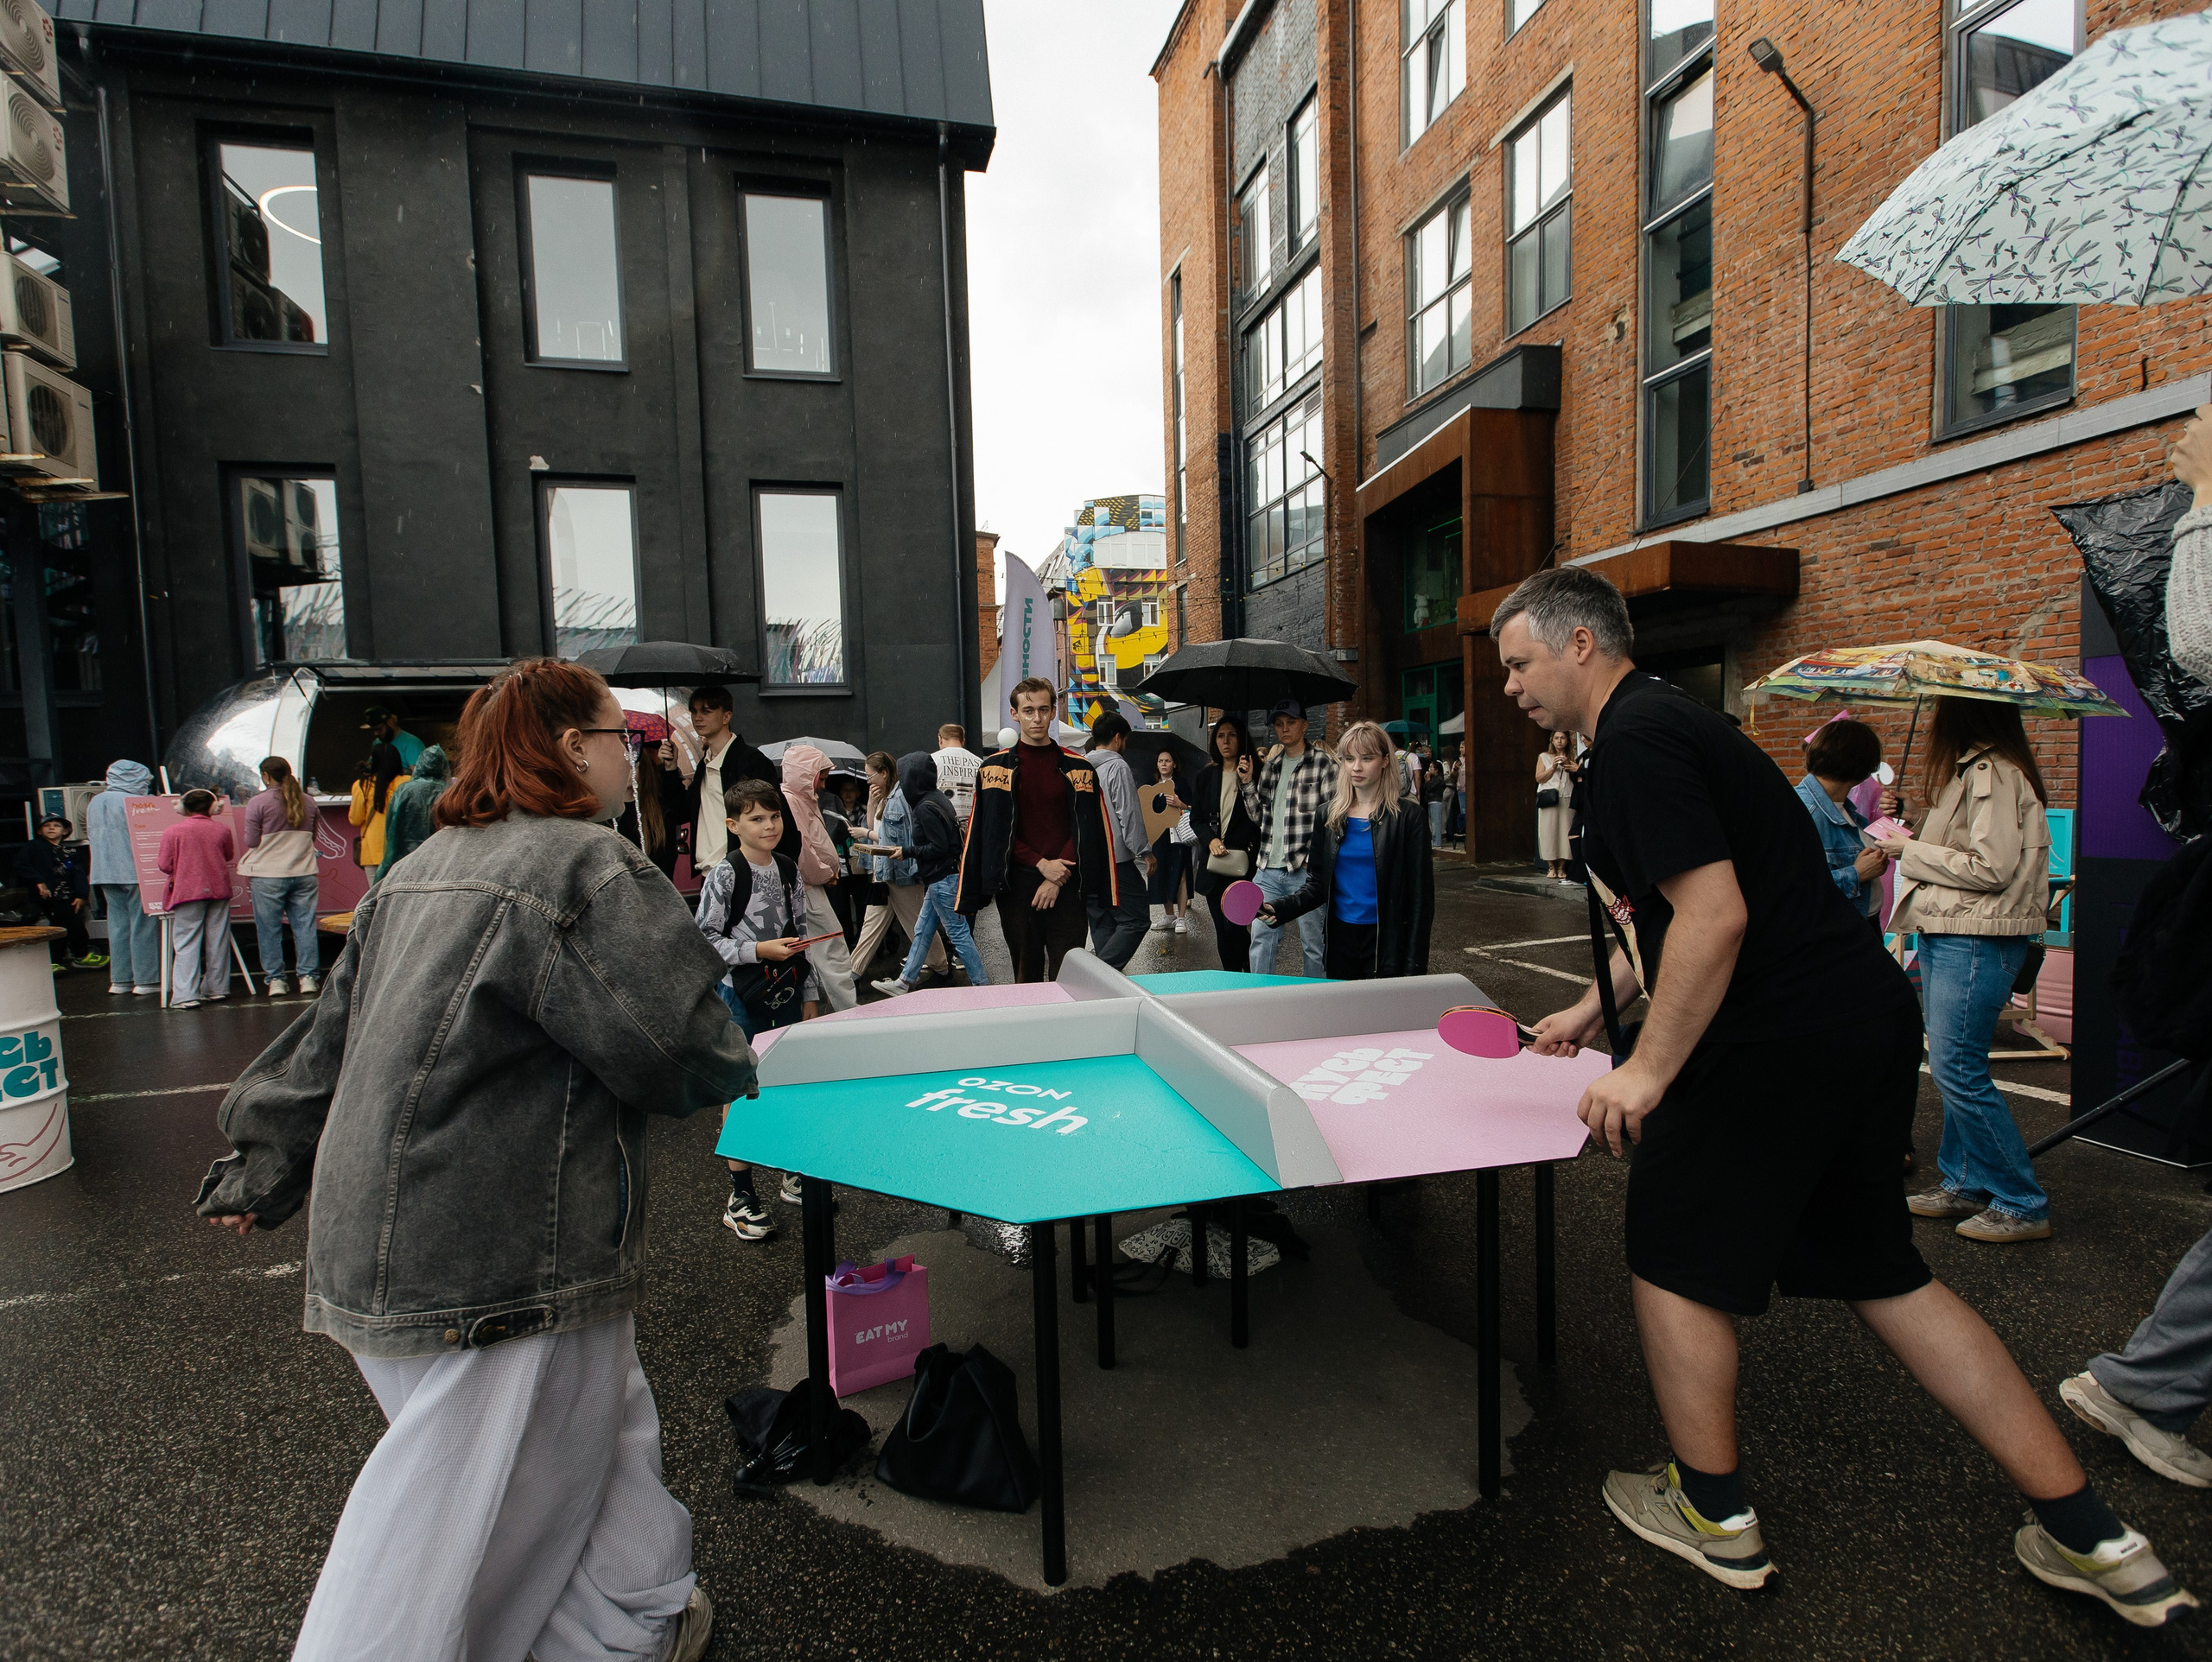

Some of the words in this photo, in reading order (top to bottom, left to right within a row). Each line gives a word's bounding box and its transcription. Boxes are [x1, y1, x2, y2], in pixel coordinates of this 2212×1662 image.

[940, 756, 960, 766] THE
[957, 1077, 1073, 1101] OZON
[905, 1088, 1089, 1135] fresh
[855, 1325, 883, 1345] EAT
[885, 1319, 908, 1335] MY
[887, 1331, 909, 1343] brand
